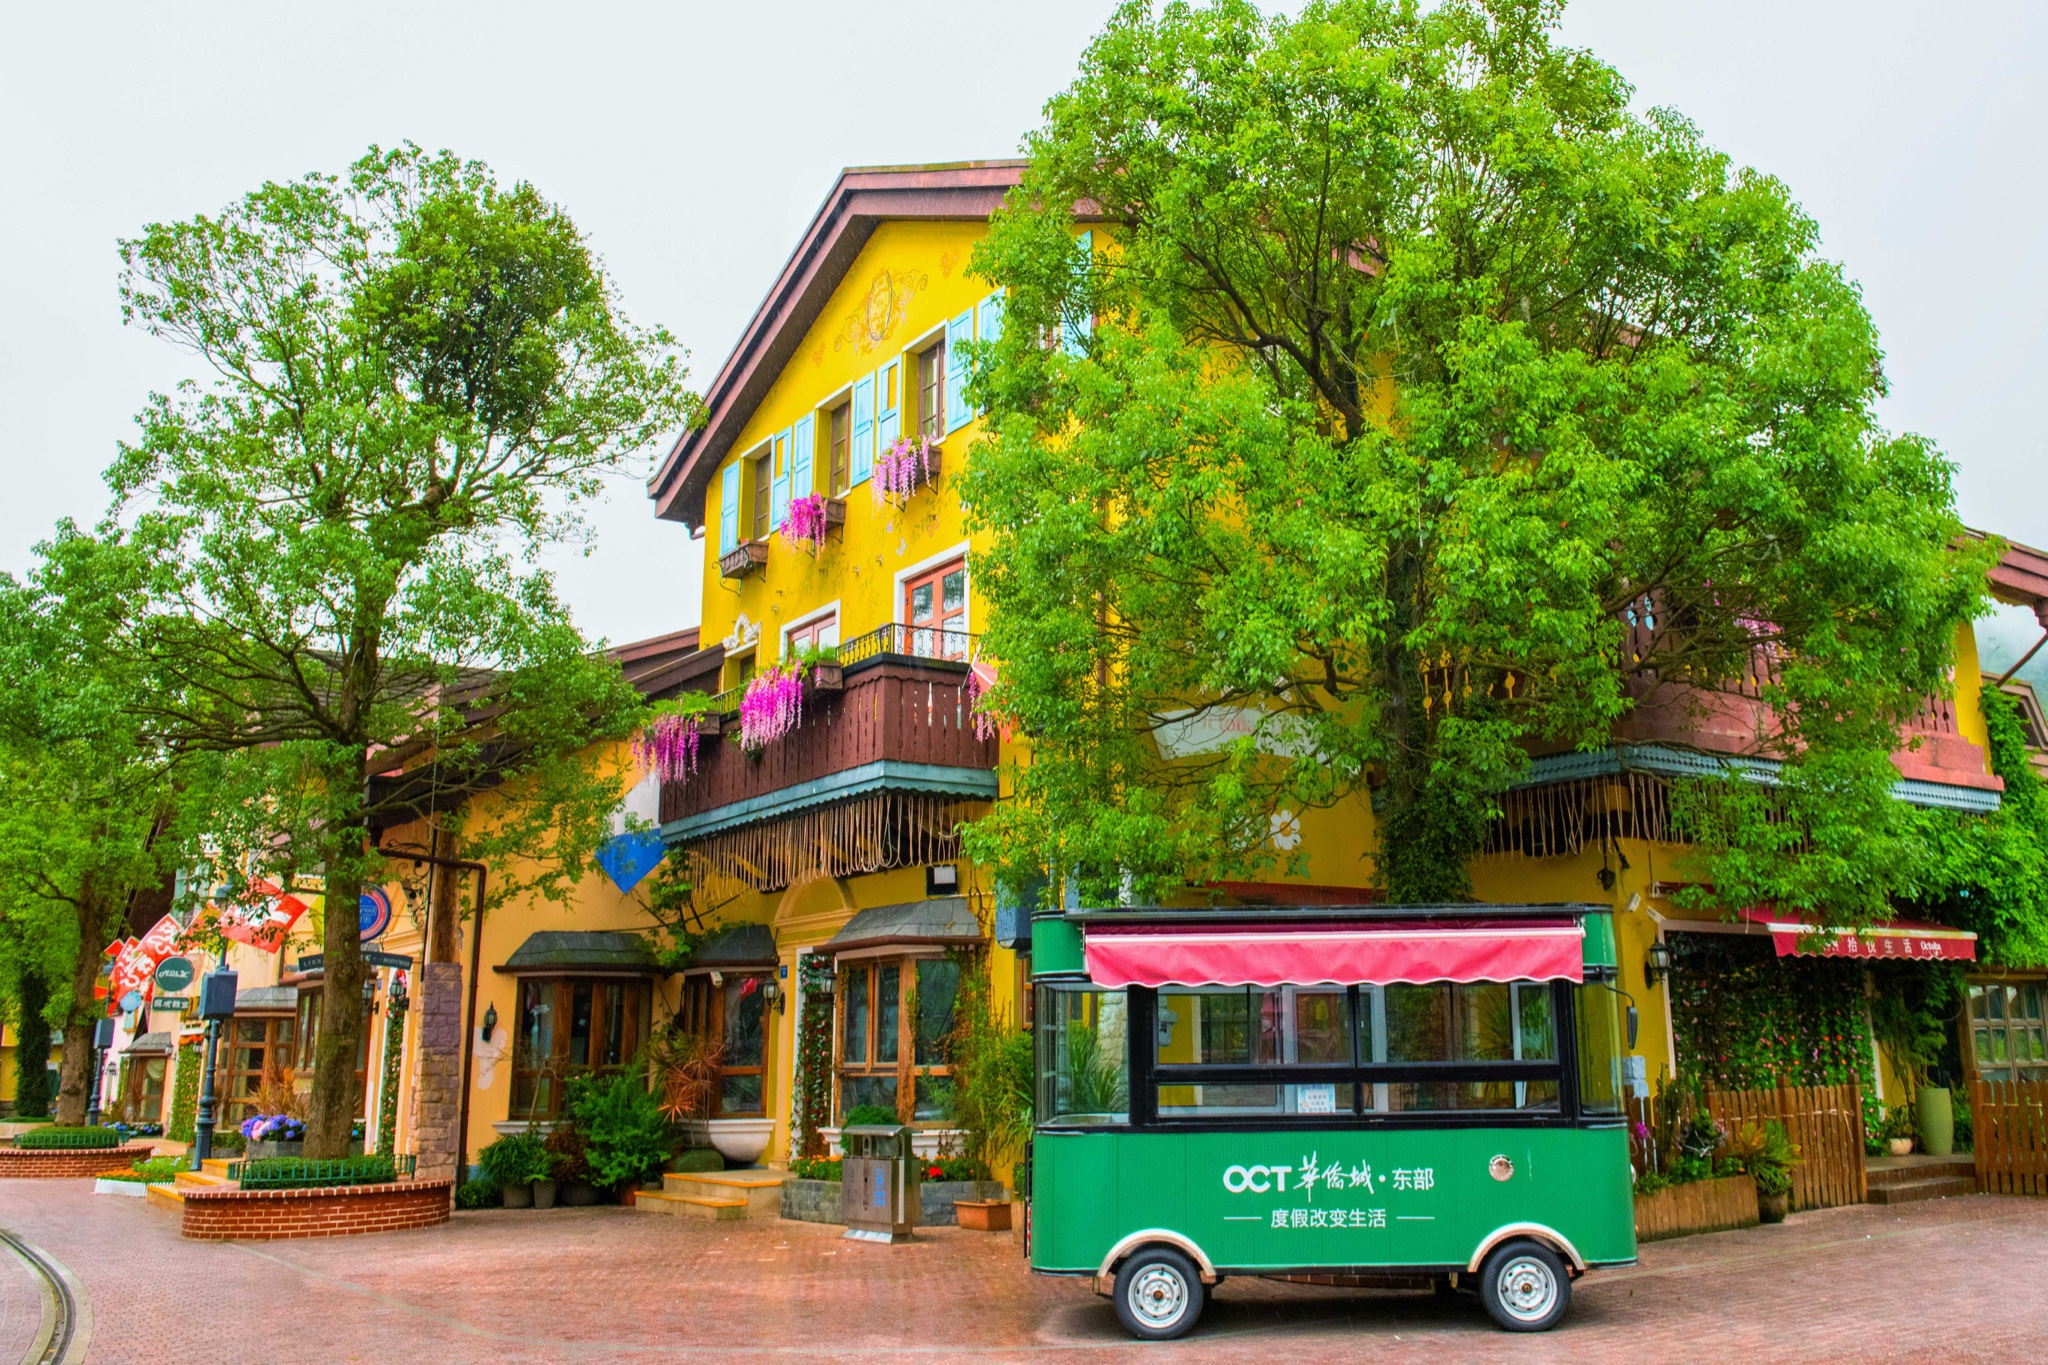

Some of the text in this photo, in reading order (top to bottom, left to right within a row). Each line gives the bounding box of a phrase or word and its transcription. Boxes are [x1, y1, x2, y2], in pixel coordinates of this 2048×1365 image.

[1223, 1165, 1292, 1193] OCT
[1271, 1208, 1387, 1228] 度假改变生活
